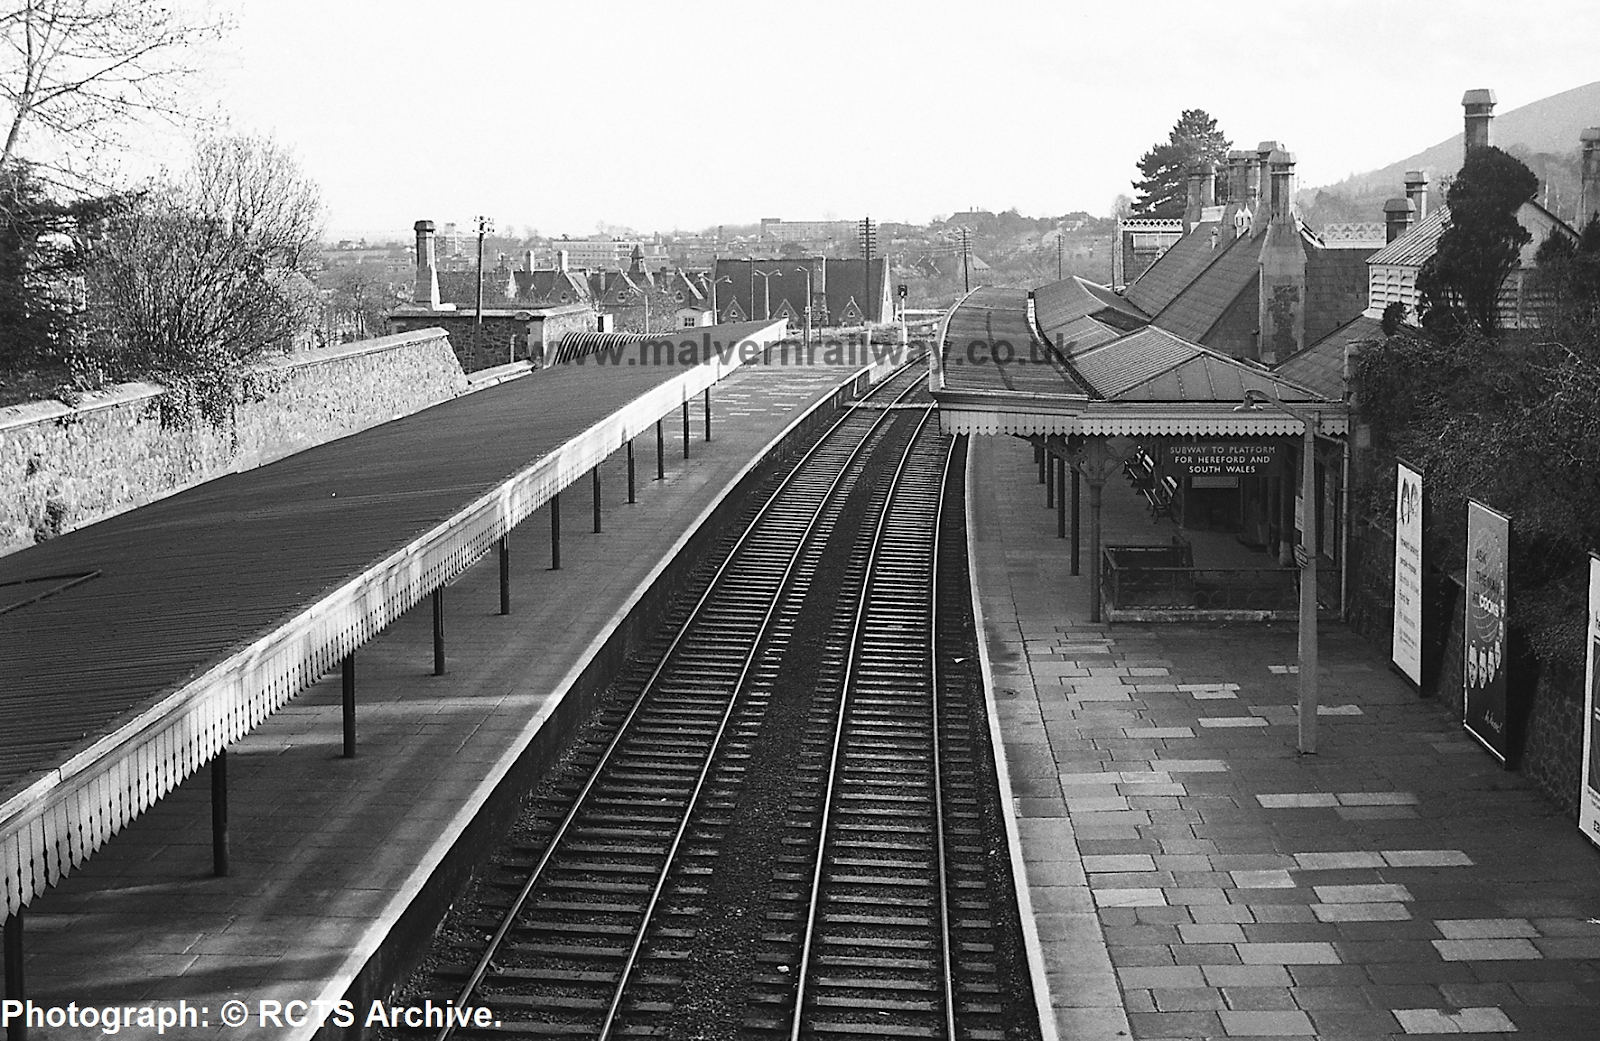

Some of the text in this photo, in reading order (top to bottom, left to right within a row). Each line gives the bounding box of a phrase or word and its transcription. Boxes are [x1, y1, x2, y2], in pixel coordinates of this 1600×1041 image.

[1170, 446, 1276, 454] SUBWAY TO PLATFORM
[1174, 456, 1271, 464] FOR HEREFORD AND
[1189, 465, 1256, 473] SOUTH WALES
